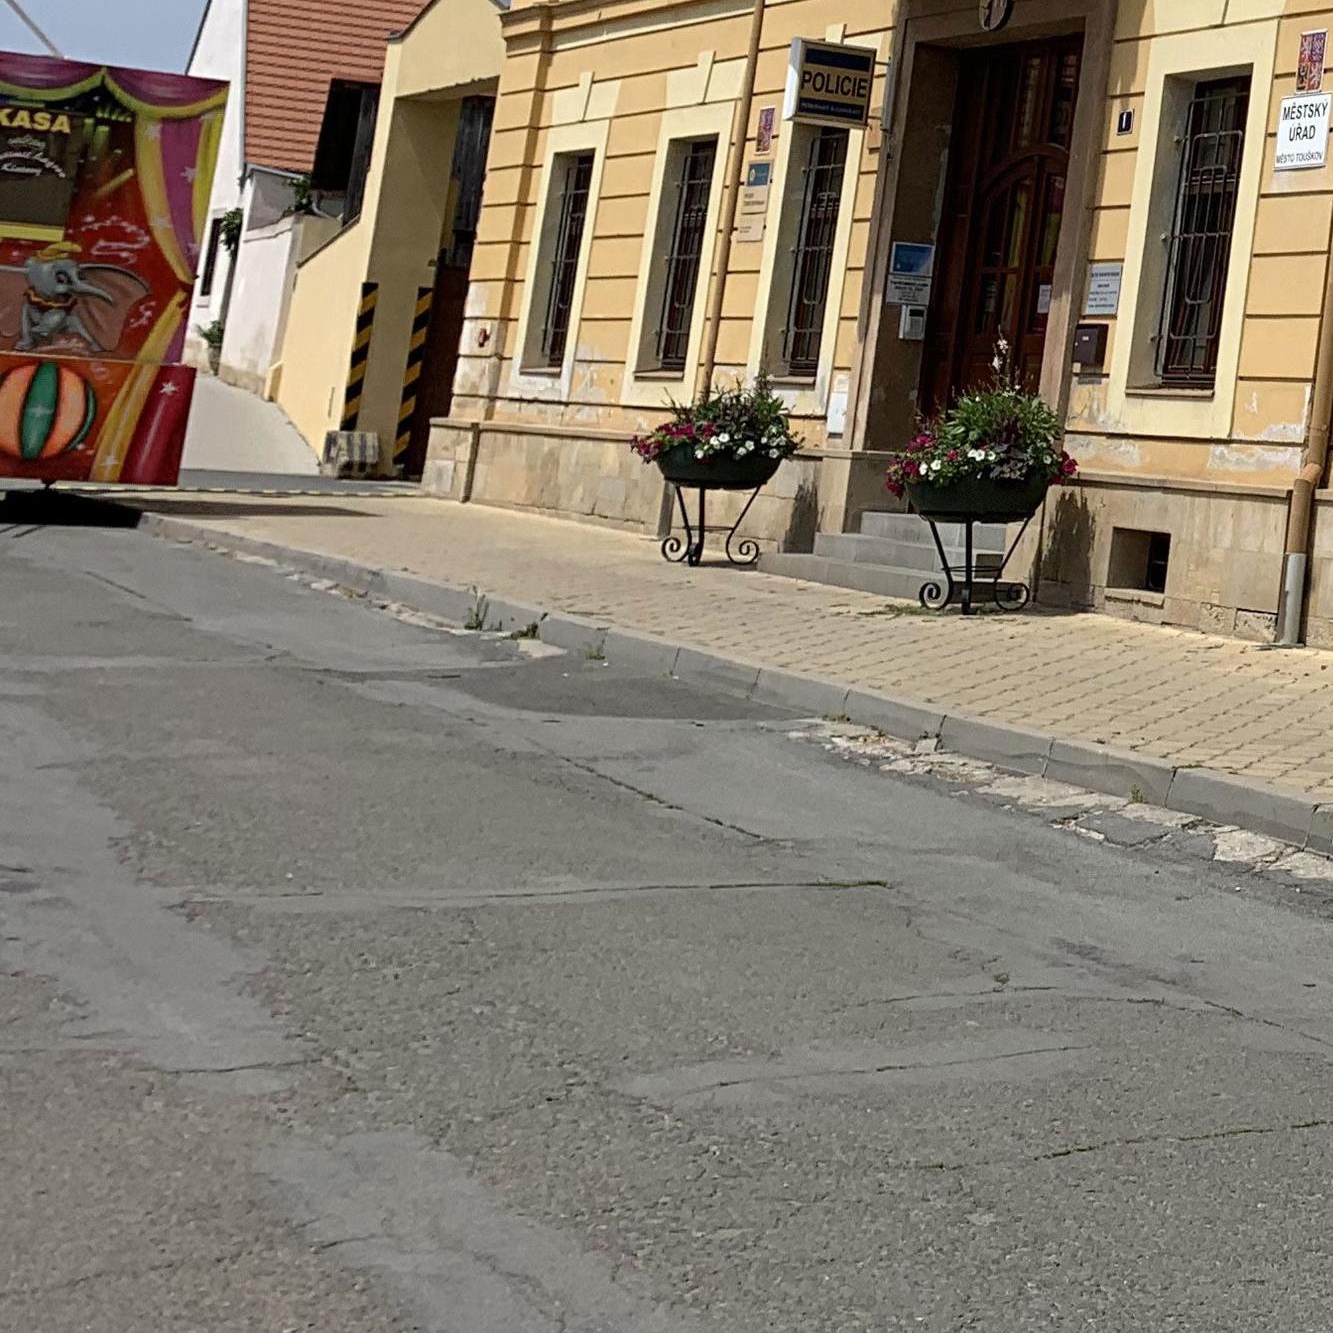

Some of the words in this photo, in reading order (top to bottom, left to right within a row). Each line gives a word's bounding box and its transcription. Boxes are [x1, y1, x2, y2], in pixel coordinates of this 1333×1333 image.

[801, 70, 869, 98] POLICIE
[1282, 98, 1329, 121] MĚSTSKÝ
[1288, 123, 1316, 142] ÚŘAD
[1276, 153, 1295, 164] MĚSTO
